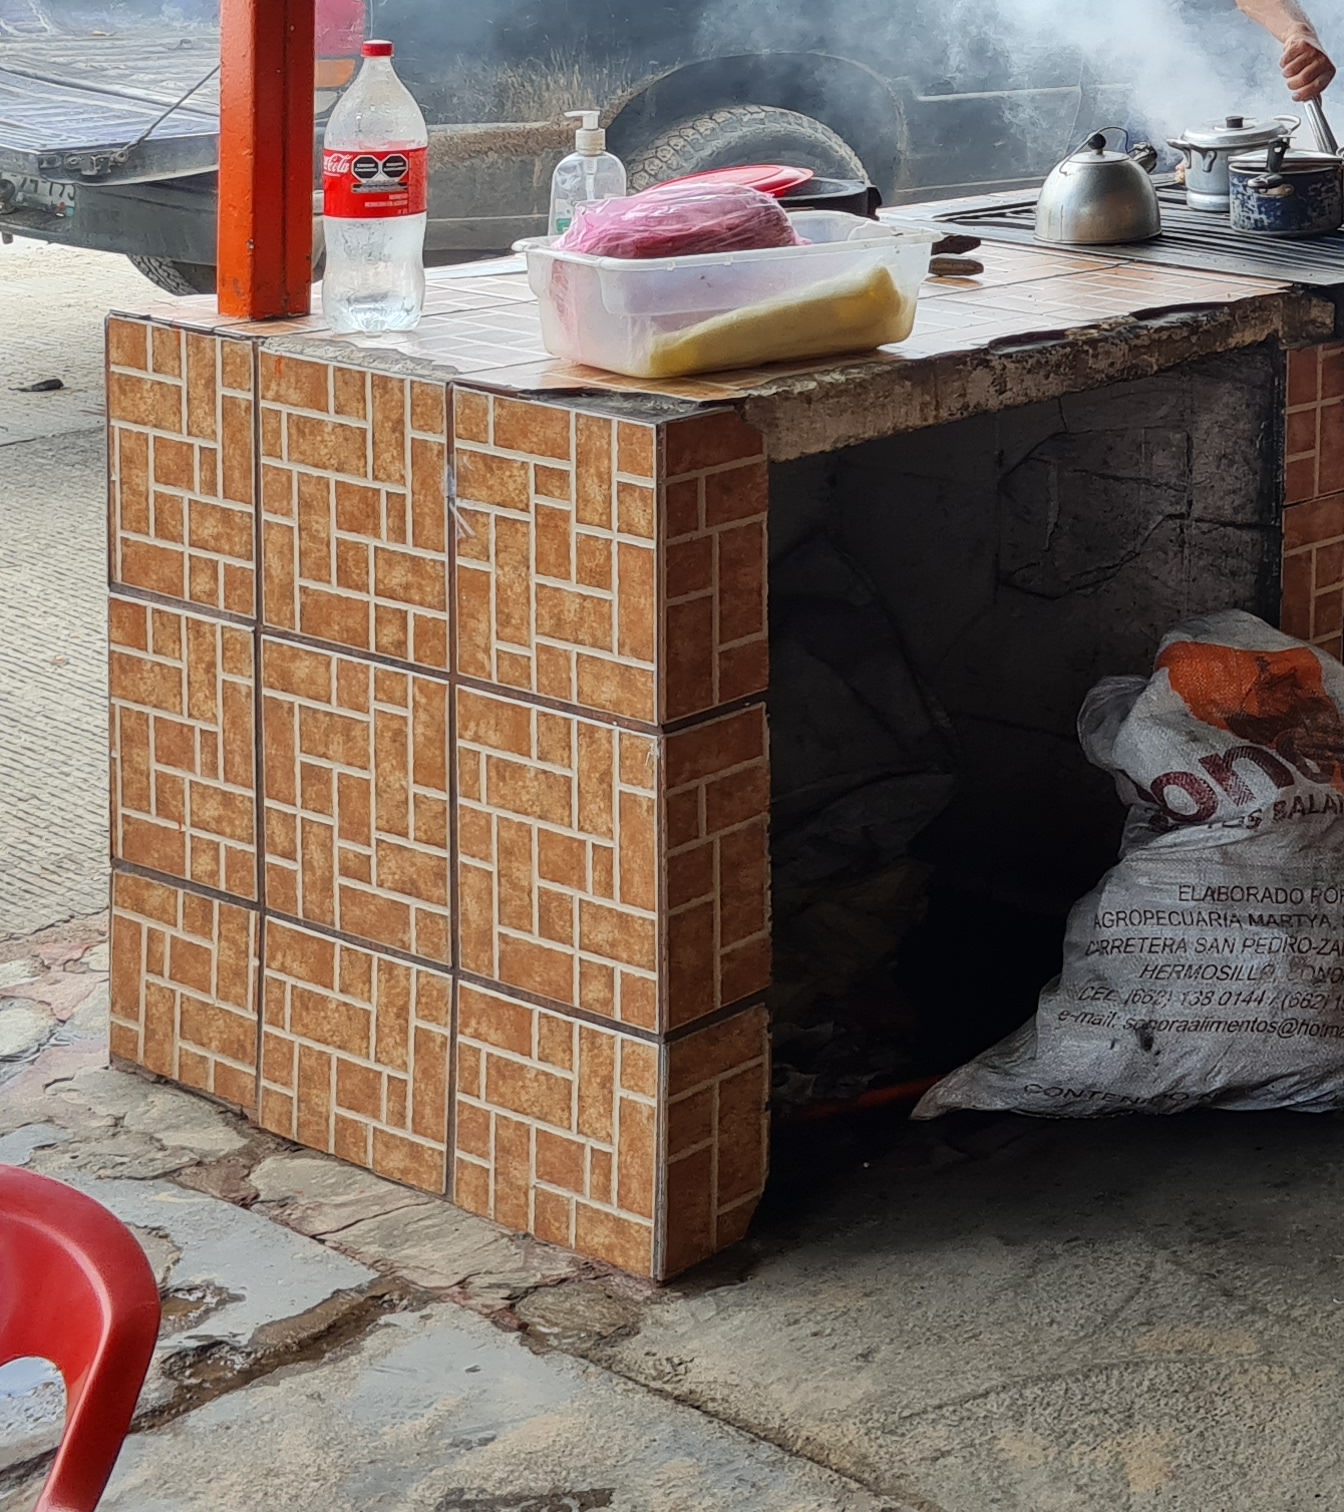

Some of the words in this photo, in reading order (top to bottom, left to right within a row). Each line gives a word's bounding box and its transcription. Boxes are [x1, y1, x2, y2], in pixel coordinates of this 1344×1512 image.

[1178, 885, 1304, 905] ELABORADO
[1093, 909, 1243, 930] AGROPECUARIA
[1194, 937, 1236, 954] SAN
[1218, 990, 1266, 1006] 0144
[1058, 1009, 1118, 1029] e-mail:
